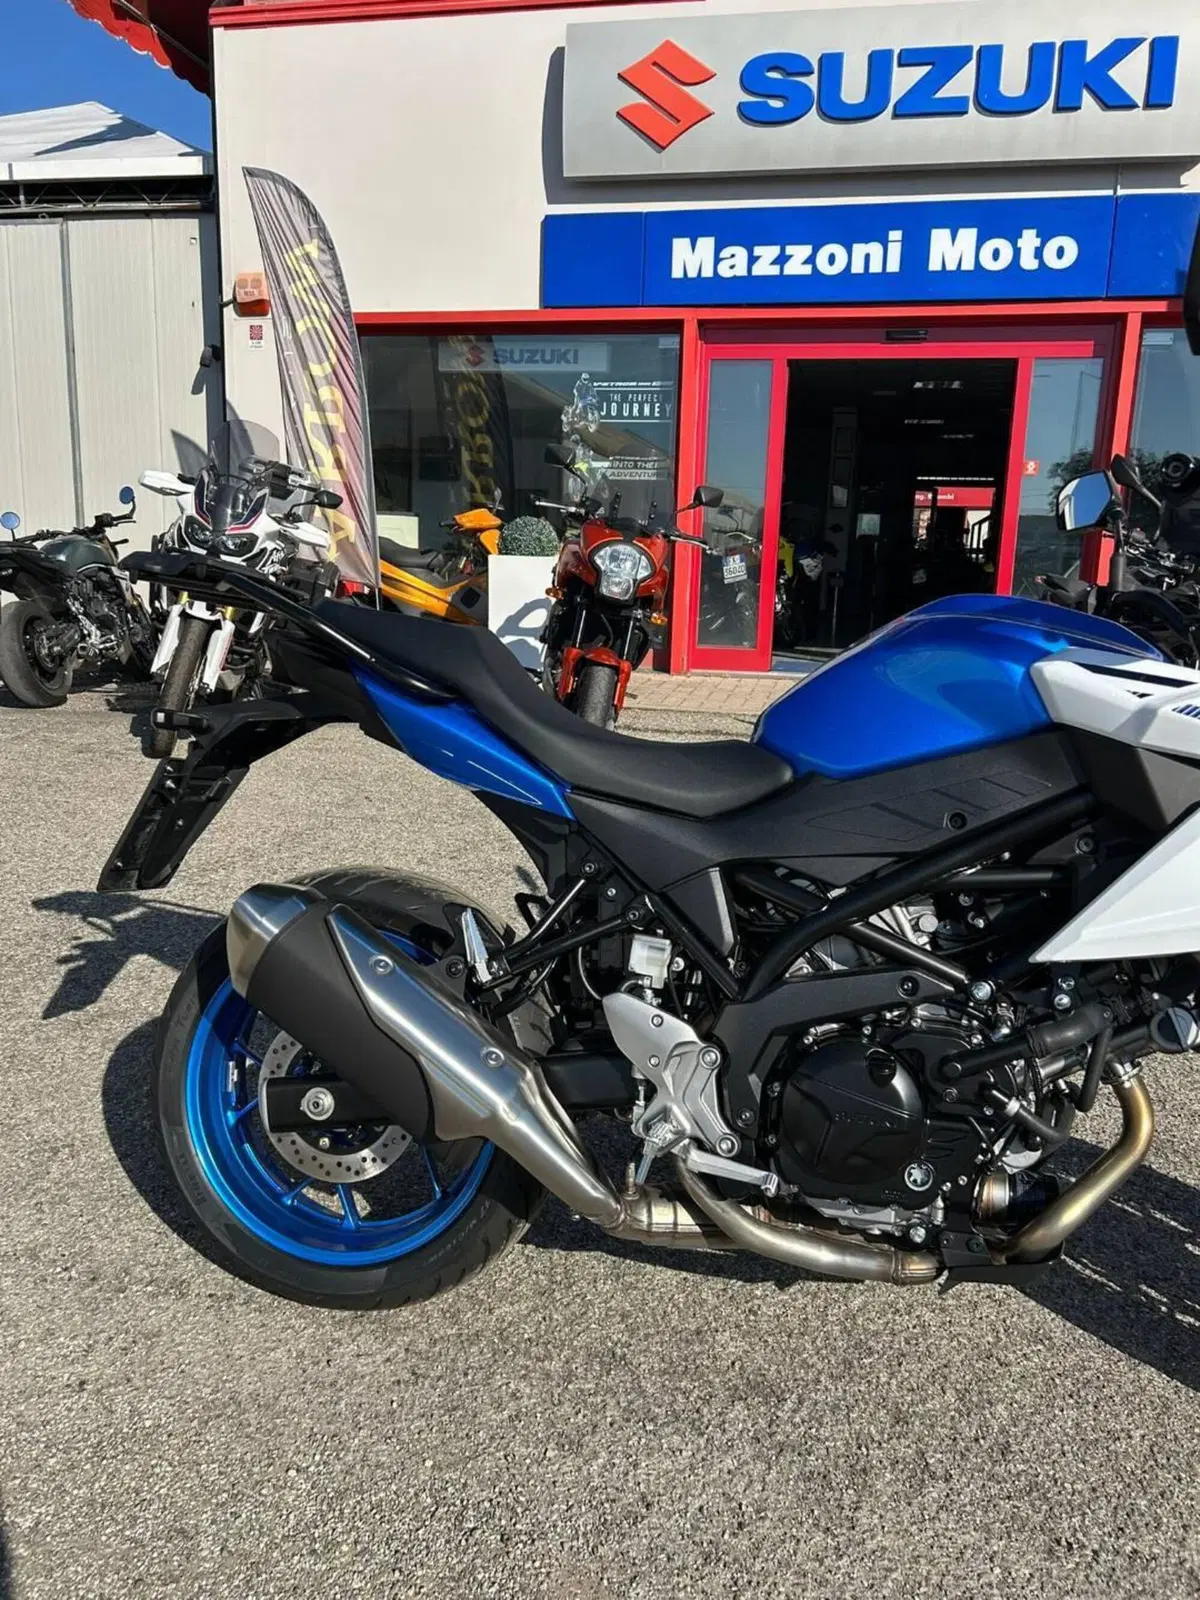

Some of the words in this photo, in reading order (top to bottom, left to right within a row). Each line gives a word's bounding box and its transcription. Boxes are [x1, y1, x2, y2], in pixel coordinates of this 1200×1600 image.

[738, 36, 1179, 126] SUZUKI
[671, 230, 903, 279] Mazzoni
[928, 228, 1079, 272] Moto
[493, 348, 579, 365] SUZUKI
[610, 394, 621, 402] THE
[600, 402, 673, 417] JOURNEY
[613, 461, 635, 469] INTO
[609, 470, 659, 479] ADVENTU
